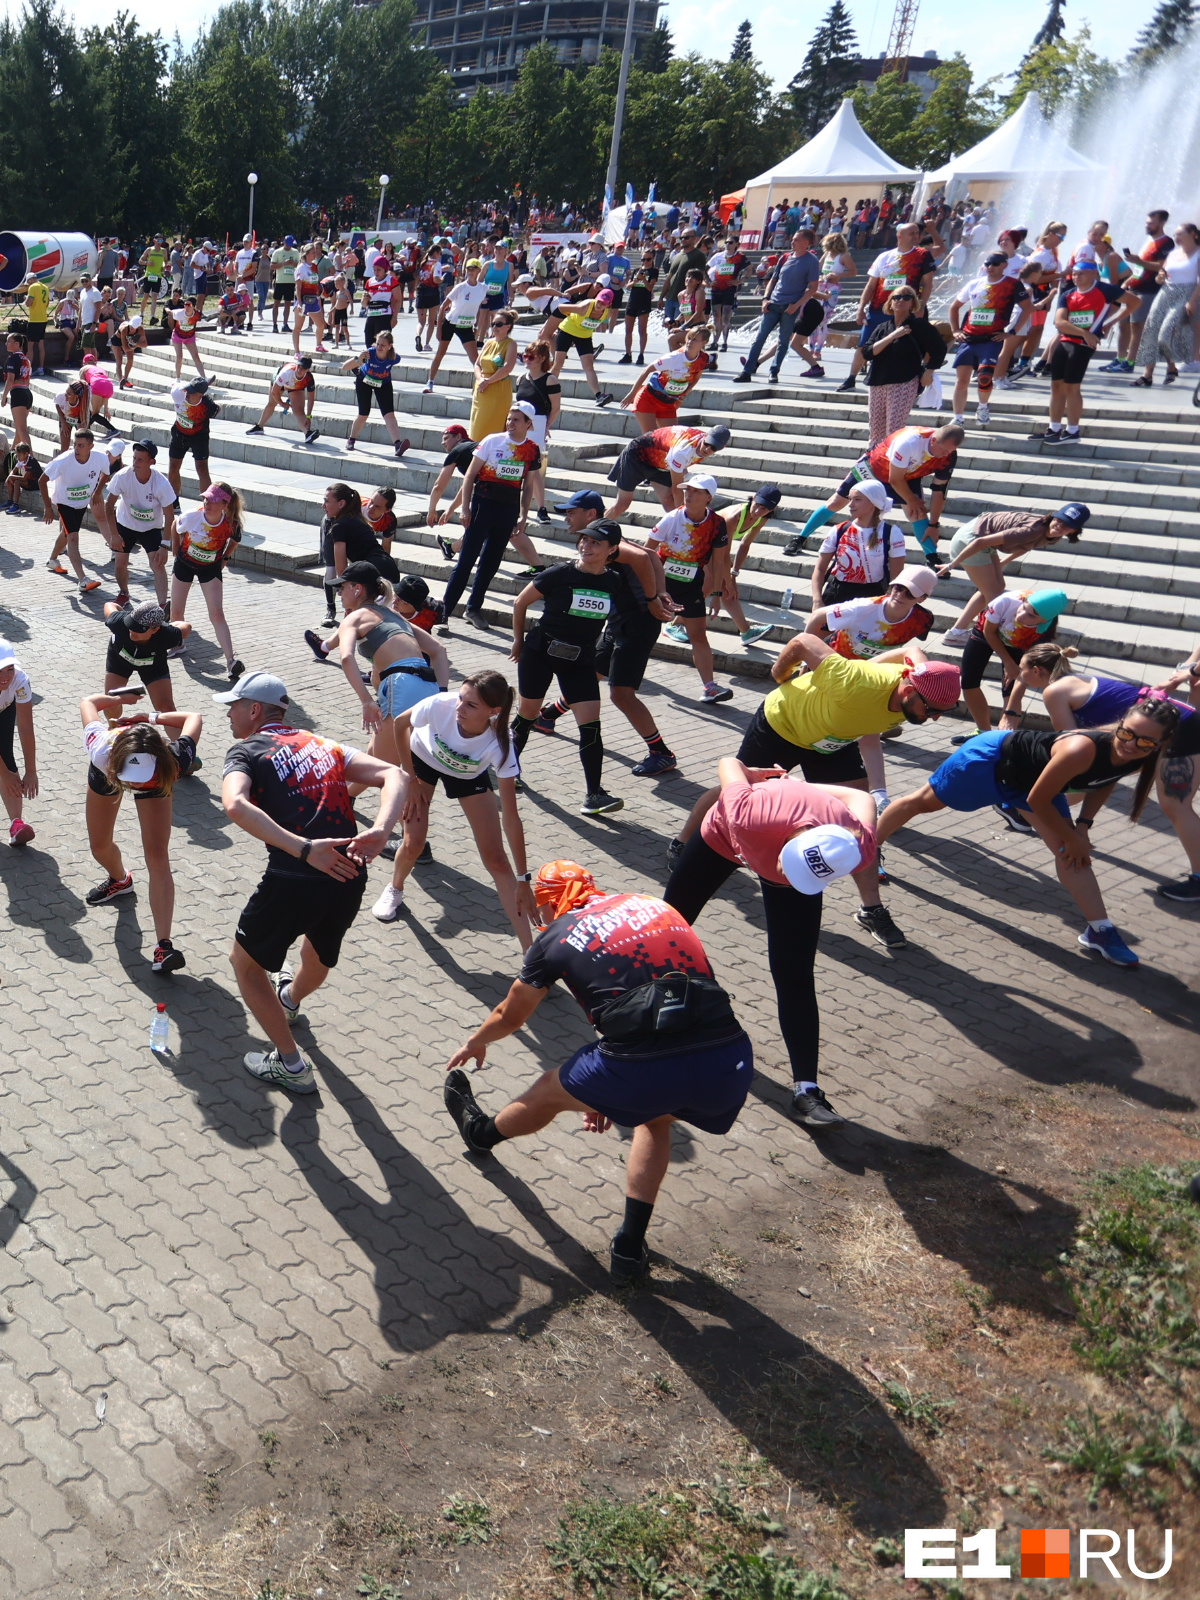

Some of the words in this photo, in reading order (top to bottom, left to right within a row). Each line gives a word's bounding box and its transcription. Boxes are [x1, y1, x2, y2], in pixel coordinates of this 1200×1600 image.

[41, 289, 47, 304] 2
[973, 313, 989, 321] 5161
[1070, 316, 1089, 324] 5023
[500, 466, 520, 475] 5089
[133, 510, 150, 519] 5061
[668, 565, 691, 576] 4231
[578, 598, 605, 611] 5550
[270, 744, 294, 771] БЕГИ
[277, 764, 290, 782] НА
[288, 739, 320, 770] ГРАНИЦЕ
[312, 752, 337, 781] СВЕТА
[294, 755, 316, 783] ДВУХ
[806, 849, 832, 875] OBEY
[566, 914, 595, 946] БЕГИ
[596, 910, 631, 943] ДВУХ
[574, 931, 591, 953] НА
